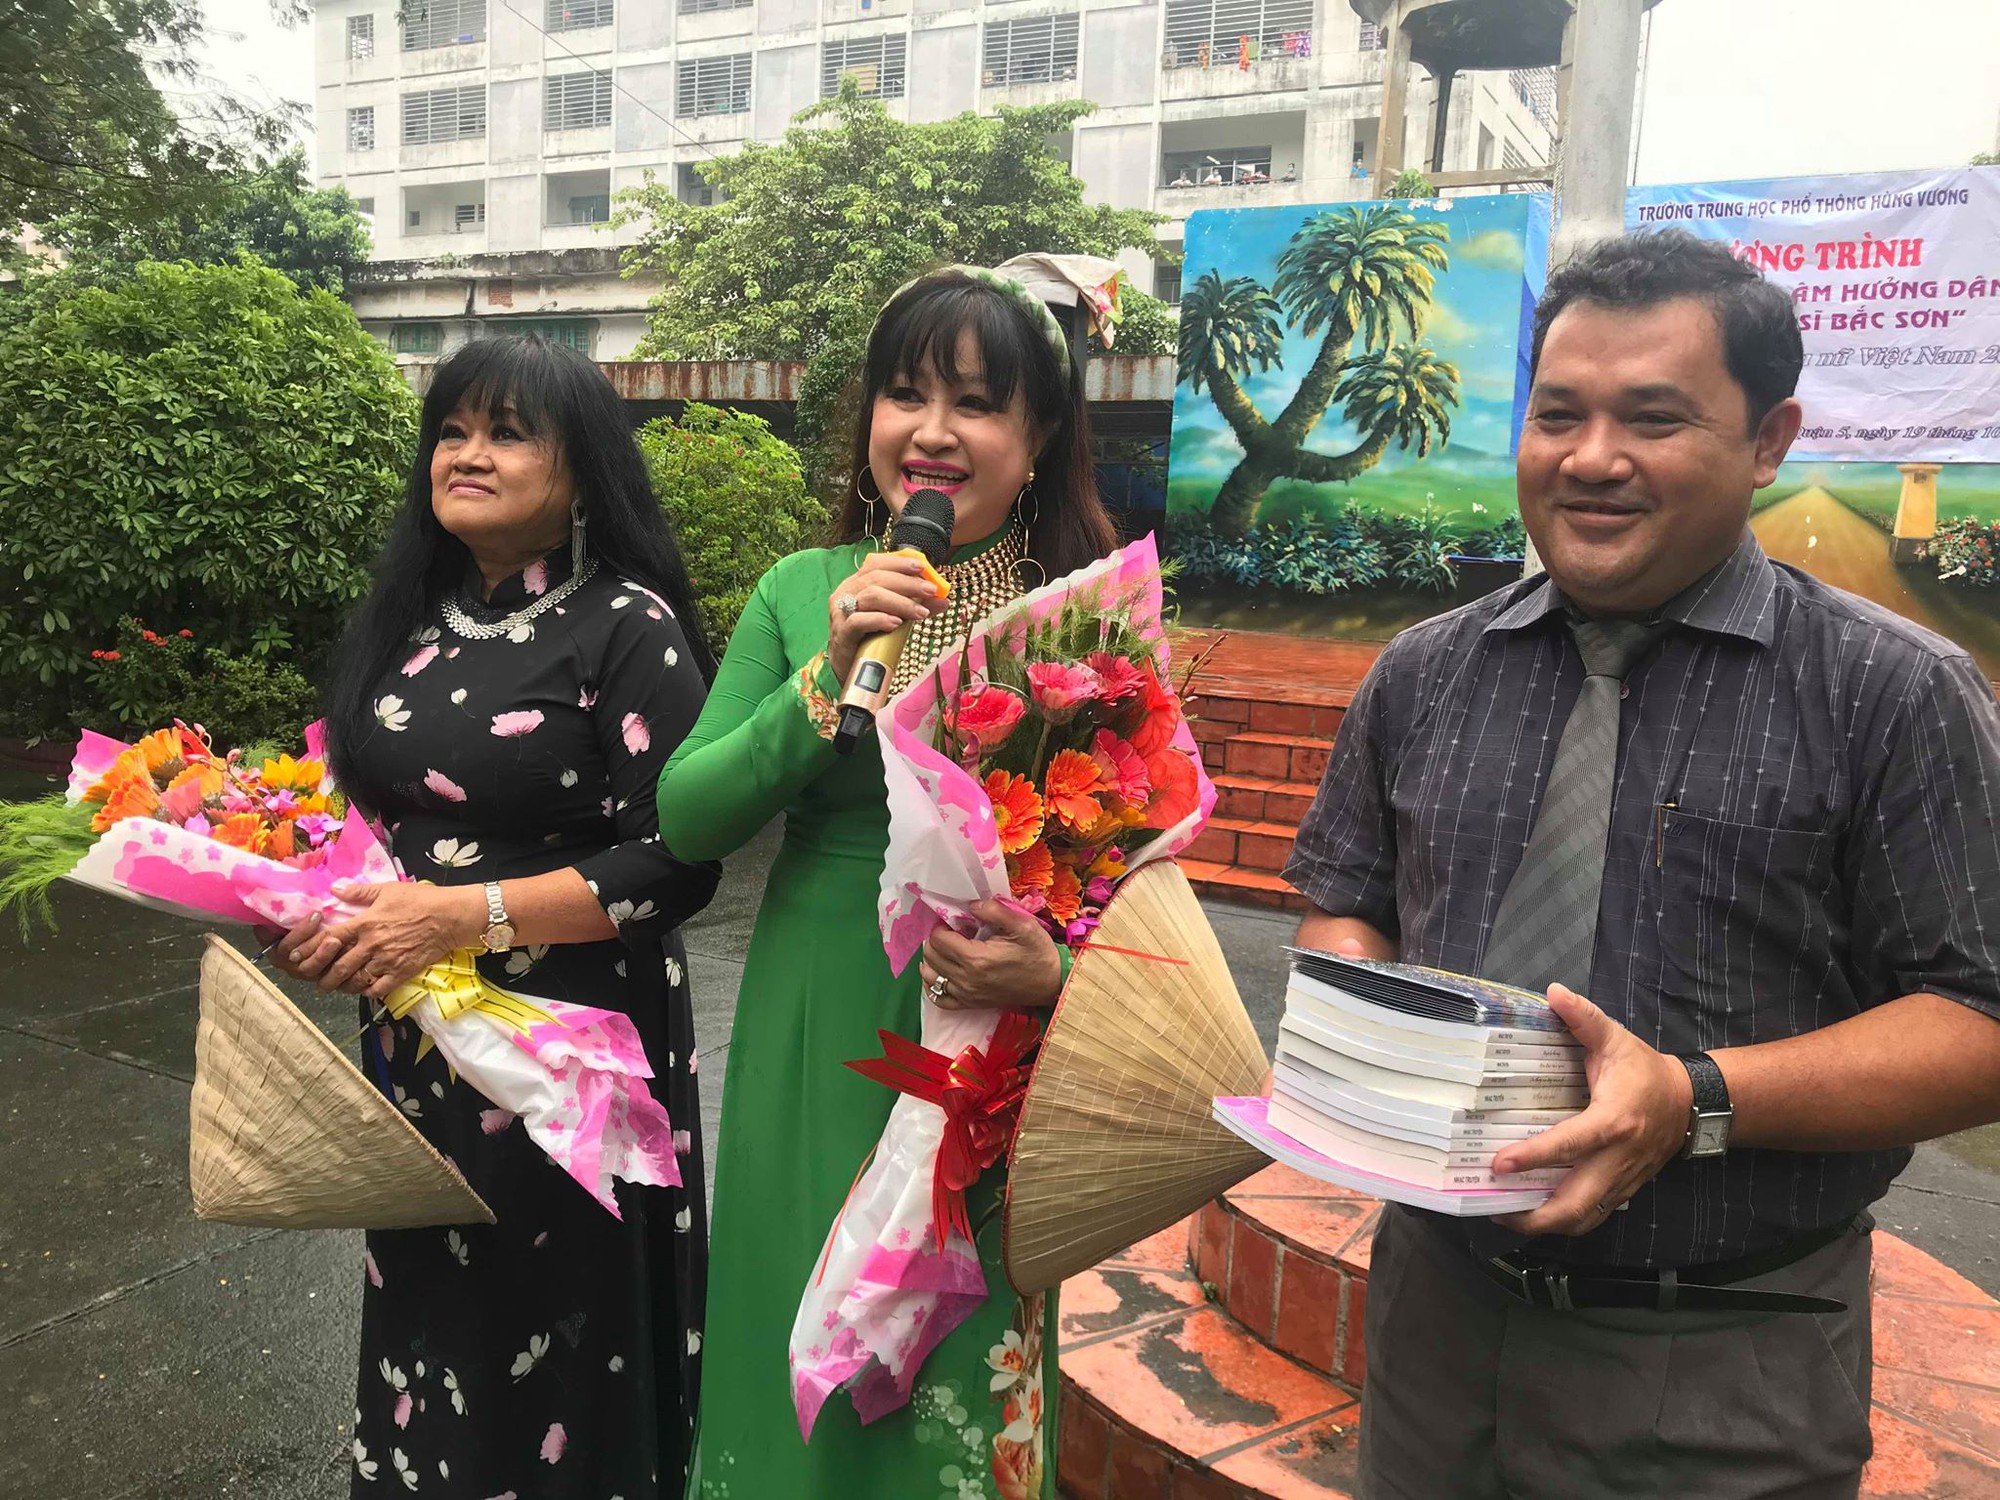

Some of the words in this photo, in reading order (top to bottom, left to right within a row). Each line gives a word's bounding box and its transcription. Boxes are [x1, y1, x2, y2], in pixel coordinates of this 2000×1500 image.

[1638, 201, 1693, 222] TRƯỜNG
[1698, 202, 1744, 219] TRUNG
[1747, 200, 1777, 219] HỌC
[1781, 192, 1812, 215] PHỔ
[1816, 193, 1866, 213] THÔNG
[1870, 191, 1913, 211] HÙNG
[1917, 187, 1969, 207] VƯƠNG
[1815, 231, 1923, 271] TRÌNH
[1841, 276, 1938, 303] HƯỞNG
[1799, 309, 1823, 331] SĨ
[1830, 305, 1885, 332] BẮC
[1814, 347, 1855, 367] nữ
[1860, 346, 1912, 370] Việt
[1913, 345, 1977, 365] Nam
[1835, 426, 1852, 440] 5,
[1902, 426, 1926, 438] 19
[1926, 426, 1979, 441] tháng
